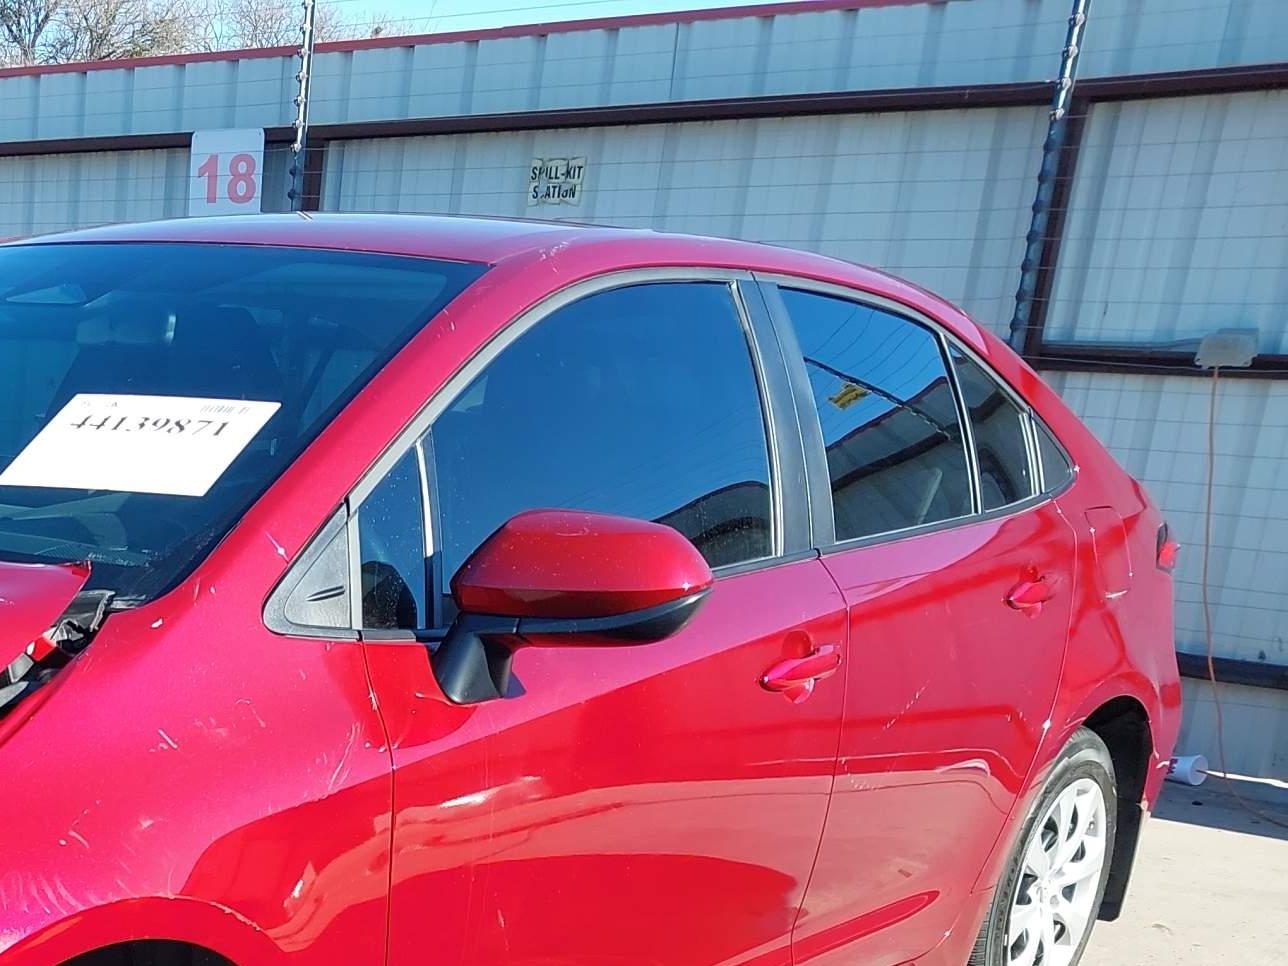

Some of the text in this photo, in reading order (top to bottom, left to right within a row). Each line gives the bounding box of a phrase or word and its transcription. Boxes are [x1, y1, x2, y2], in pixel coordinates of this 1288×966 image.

[198, 152, 257, 204] 18
[530, 165, 584, 180] SPILL-KIT
[532, 184, 577, 199] SATION
[70, 415, 230, 436] 44139871
